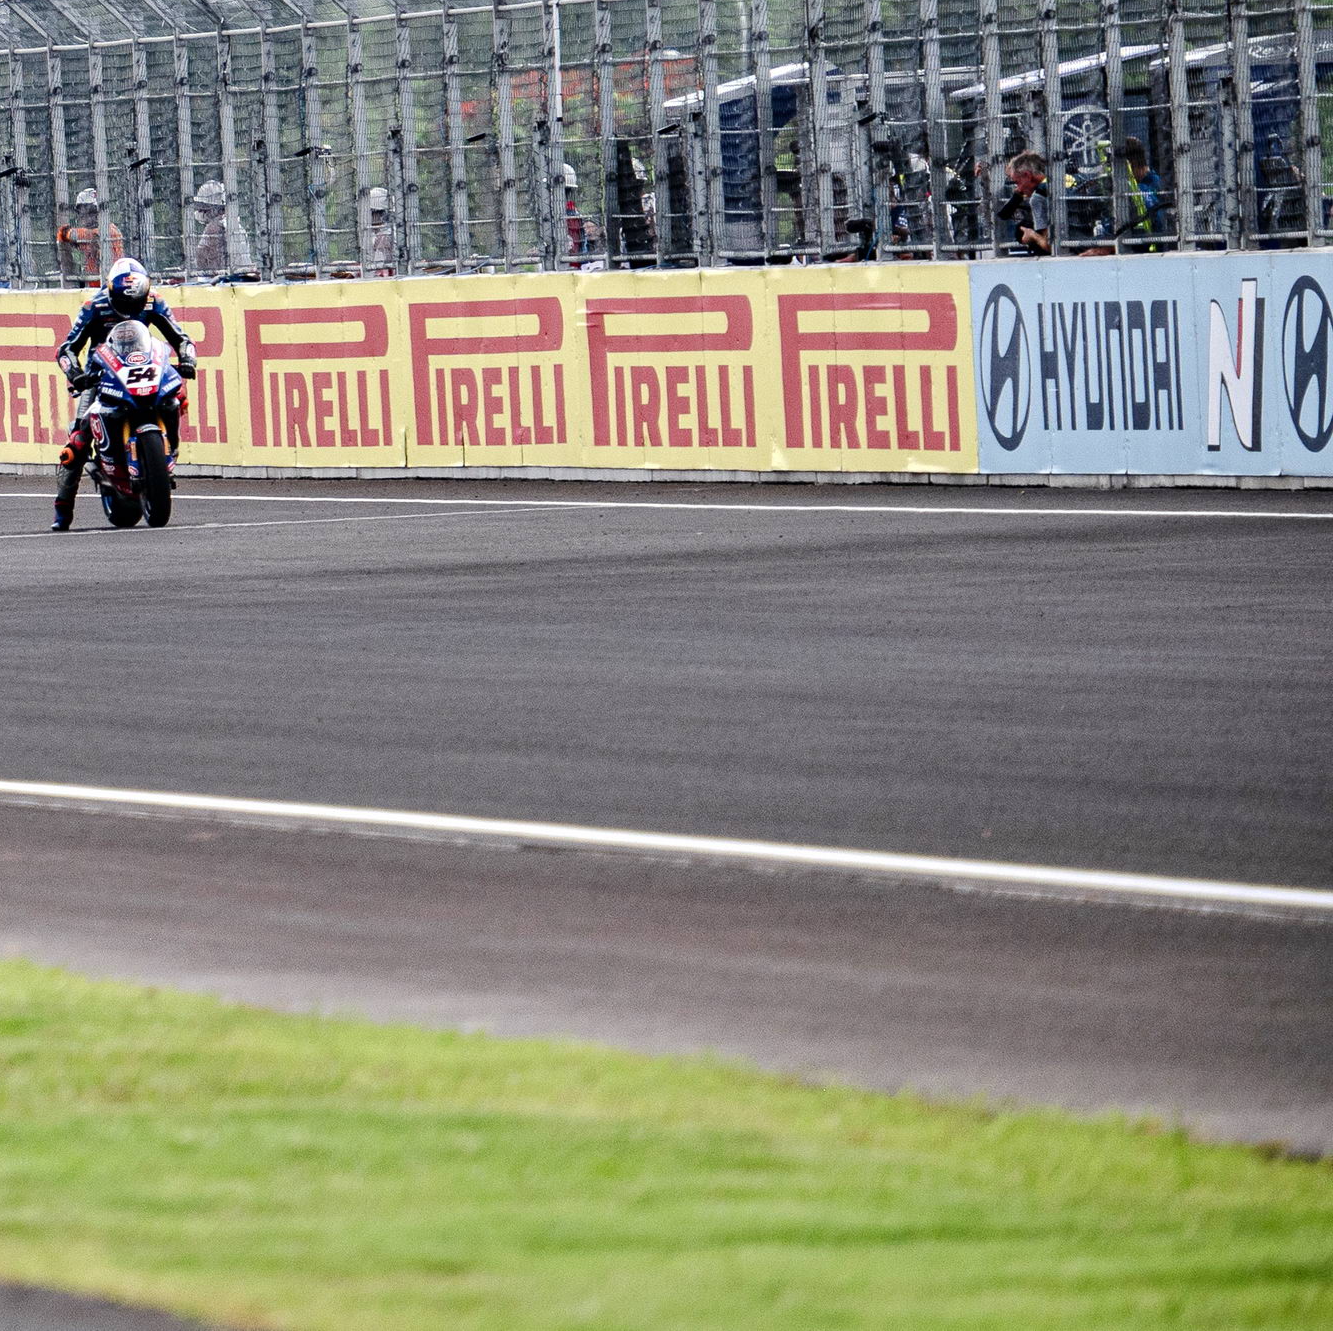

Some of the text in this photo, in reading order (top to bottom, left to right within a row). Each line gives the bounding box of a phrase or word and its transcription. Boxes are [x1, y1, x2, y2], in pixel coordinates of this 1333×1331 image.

[126, 367, 158, 385] 54
[244, 304, 394, 448] PIRELLI
[408, 296, 568, 446] PIRELLI
[585, 294, 757, 448] PIRELLI
[777, 292, 962, 452] PIRELLI
[1037, 299, 1184, 431] HYUNDAI
